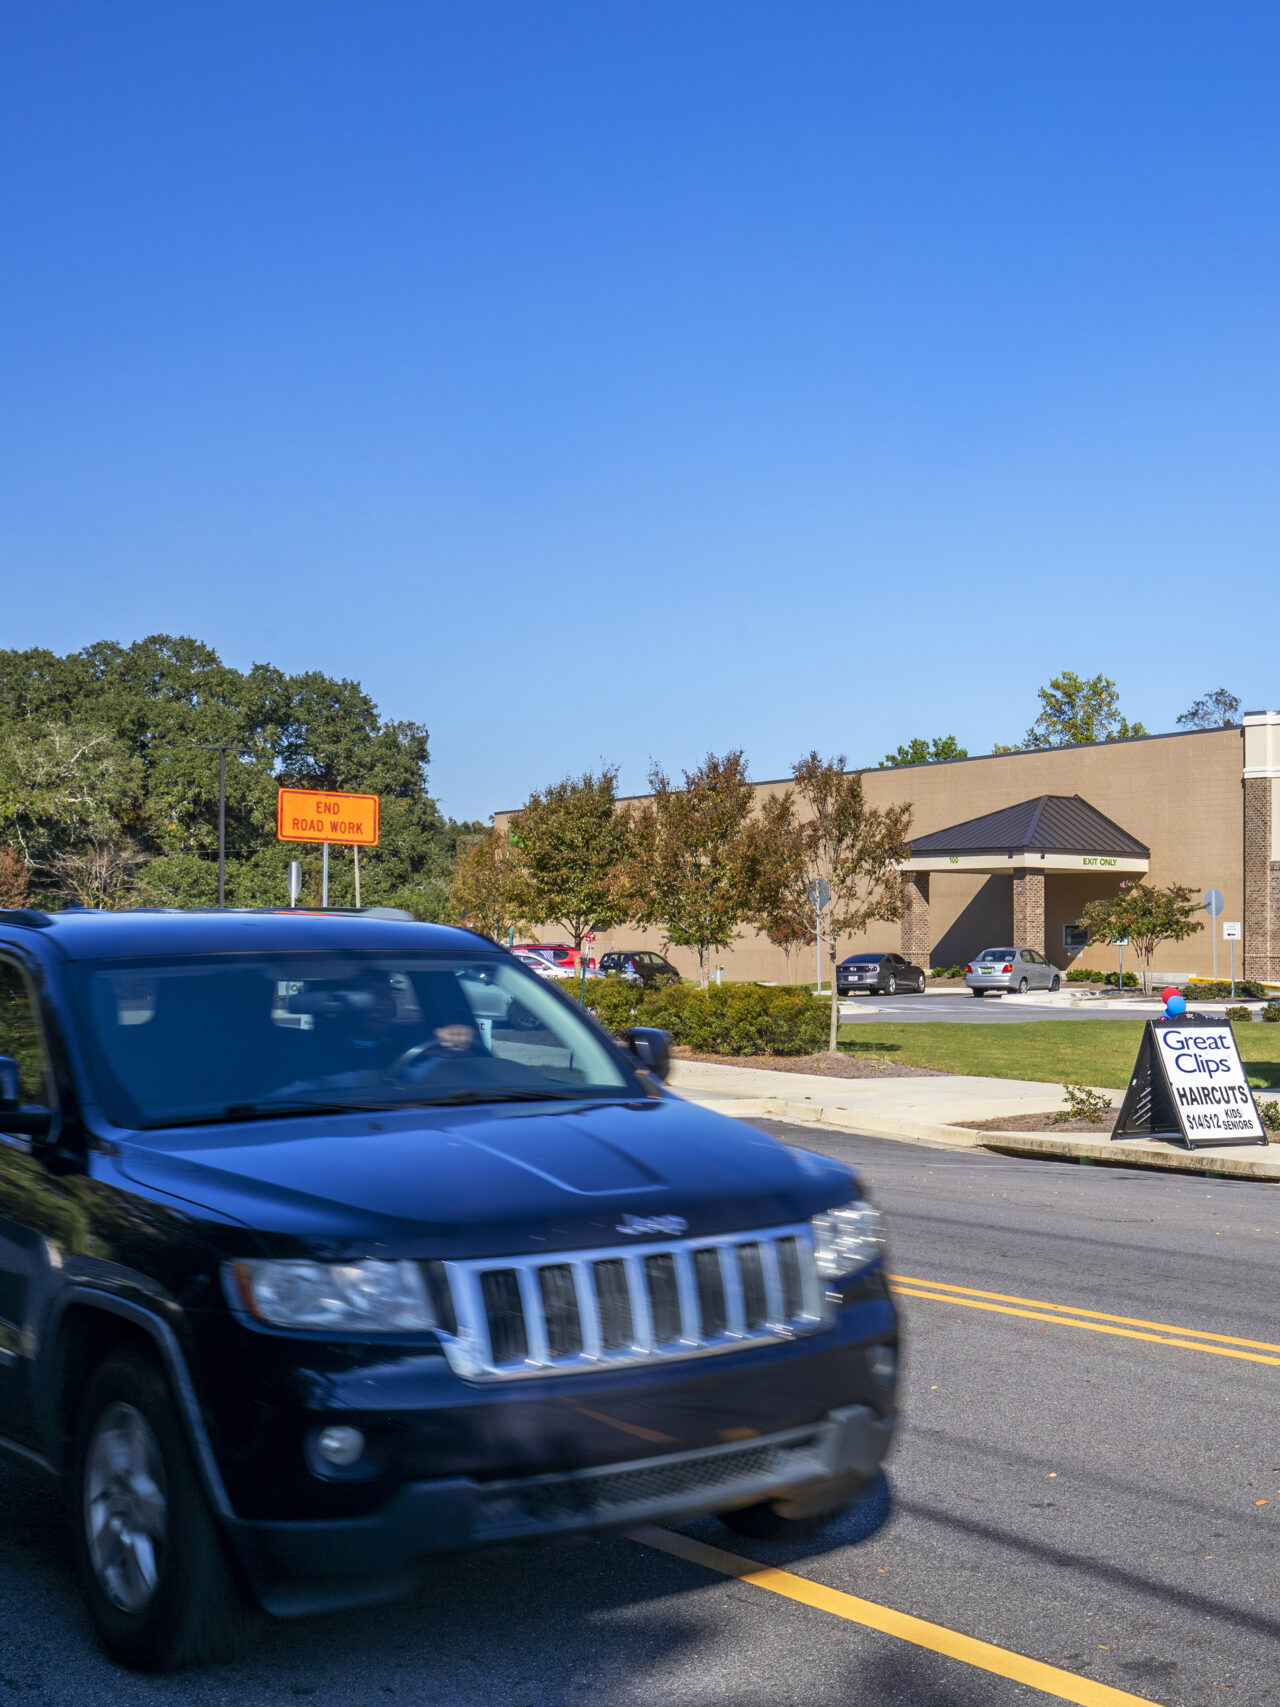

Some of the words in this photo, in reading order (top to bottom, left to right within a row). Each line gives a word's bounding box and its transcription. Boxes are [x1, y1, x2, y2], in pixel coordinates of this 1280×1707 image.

[316, 801, 340, 815] END
[292, 818, 324, 832] ROAD
[330, 821, 363, 835] WORK
[950, 856, 959, 864] 100
[1083, 857, 1098, 865] EXIT
[1100, 858, 1117, 866] ONLY
[1163, 1030, 1231, 1051] Great
[1175, 1053, 1231, 1079] Clips
[1176, 1085, 1249, 1106] HAIRCUTS
[1222, 1119, 1254, 1131] SENIORS
